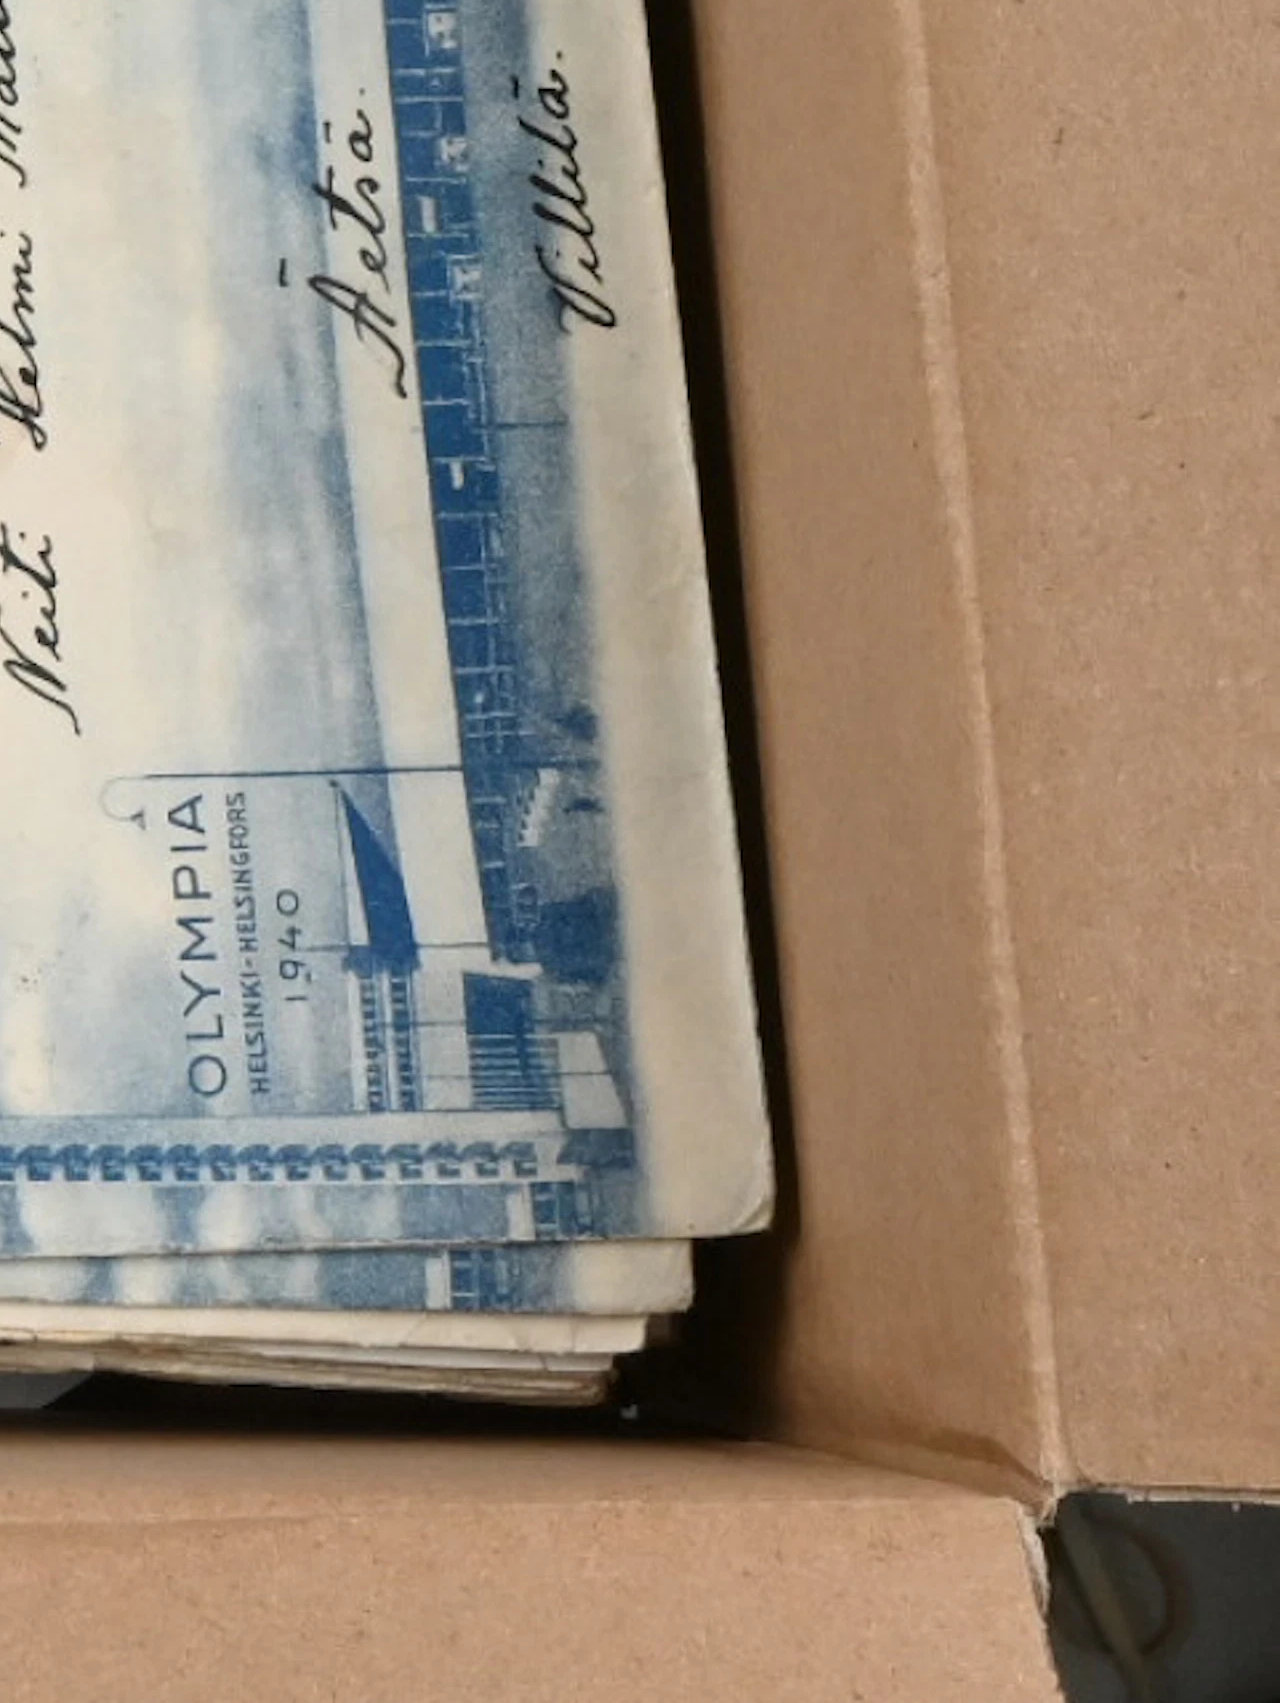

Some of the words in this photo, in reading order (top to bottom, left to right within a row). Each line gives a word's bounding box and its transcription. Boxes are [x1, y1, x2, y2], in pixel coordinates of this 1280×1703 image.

[167, 792, 229, 1098] OLYMPIA
[226, 790, 271, 1096] HELSINKI-HELSINGFORS
[275, 887, 314, 1005] 1940
